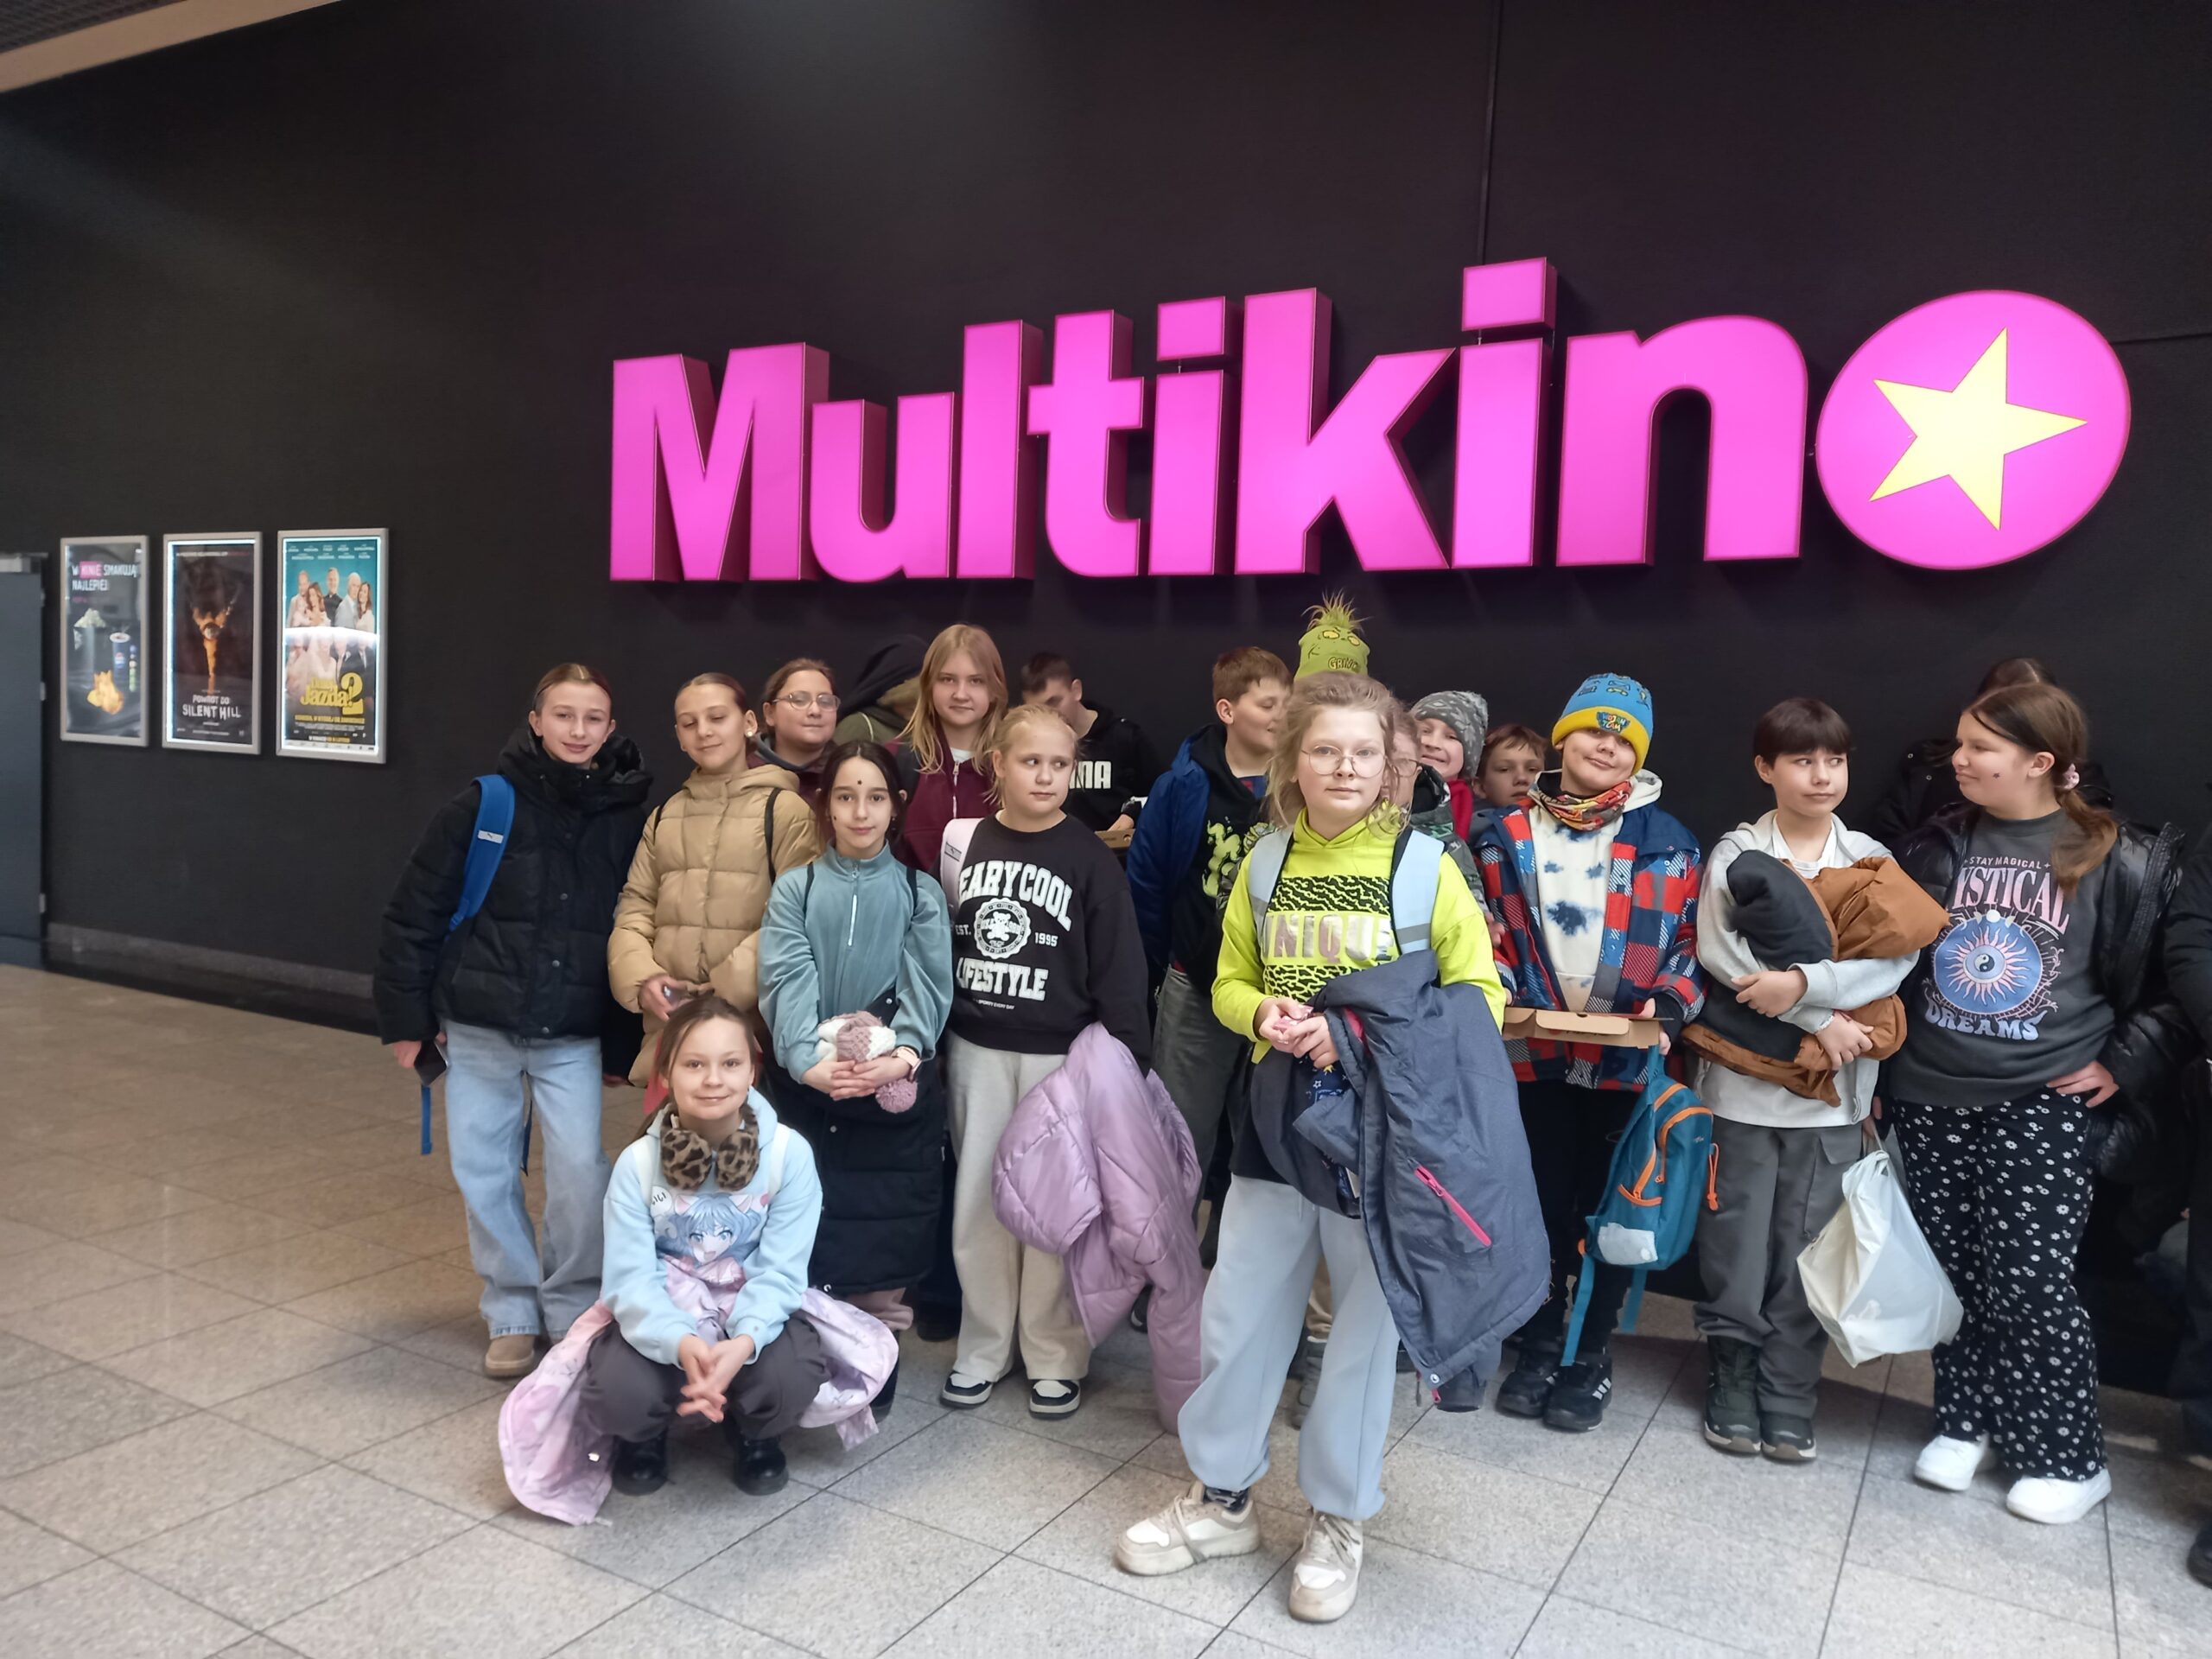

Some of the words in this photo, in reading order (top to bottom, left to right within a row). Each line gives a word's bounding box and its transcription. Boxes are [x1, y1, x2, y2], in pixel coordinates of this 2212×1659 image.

[609, 256, 2131, 583] Multikino
[1328, 657, 1361, 673] GRINC
[340, 672, 364, 715] 2
[182, 704, 218, 718] SILENT
[219, 706, 241, 721] HILL
[1069, 760, 1112, 790] MA
[1969, 856, 1993, 866] STAY
[1995, 856, 2042, 869] MAGICAL
[958, 860, 1073, 931] EARYCOOL
[1950, 866, 2070, 935] YSTICAL
[1034, 931, 1058, 947] 1995
[1924, 999, 2049, 1041] DREAMS
